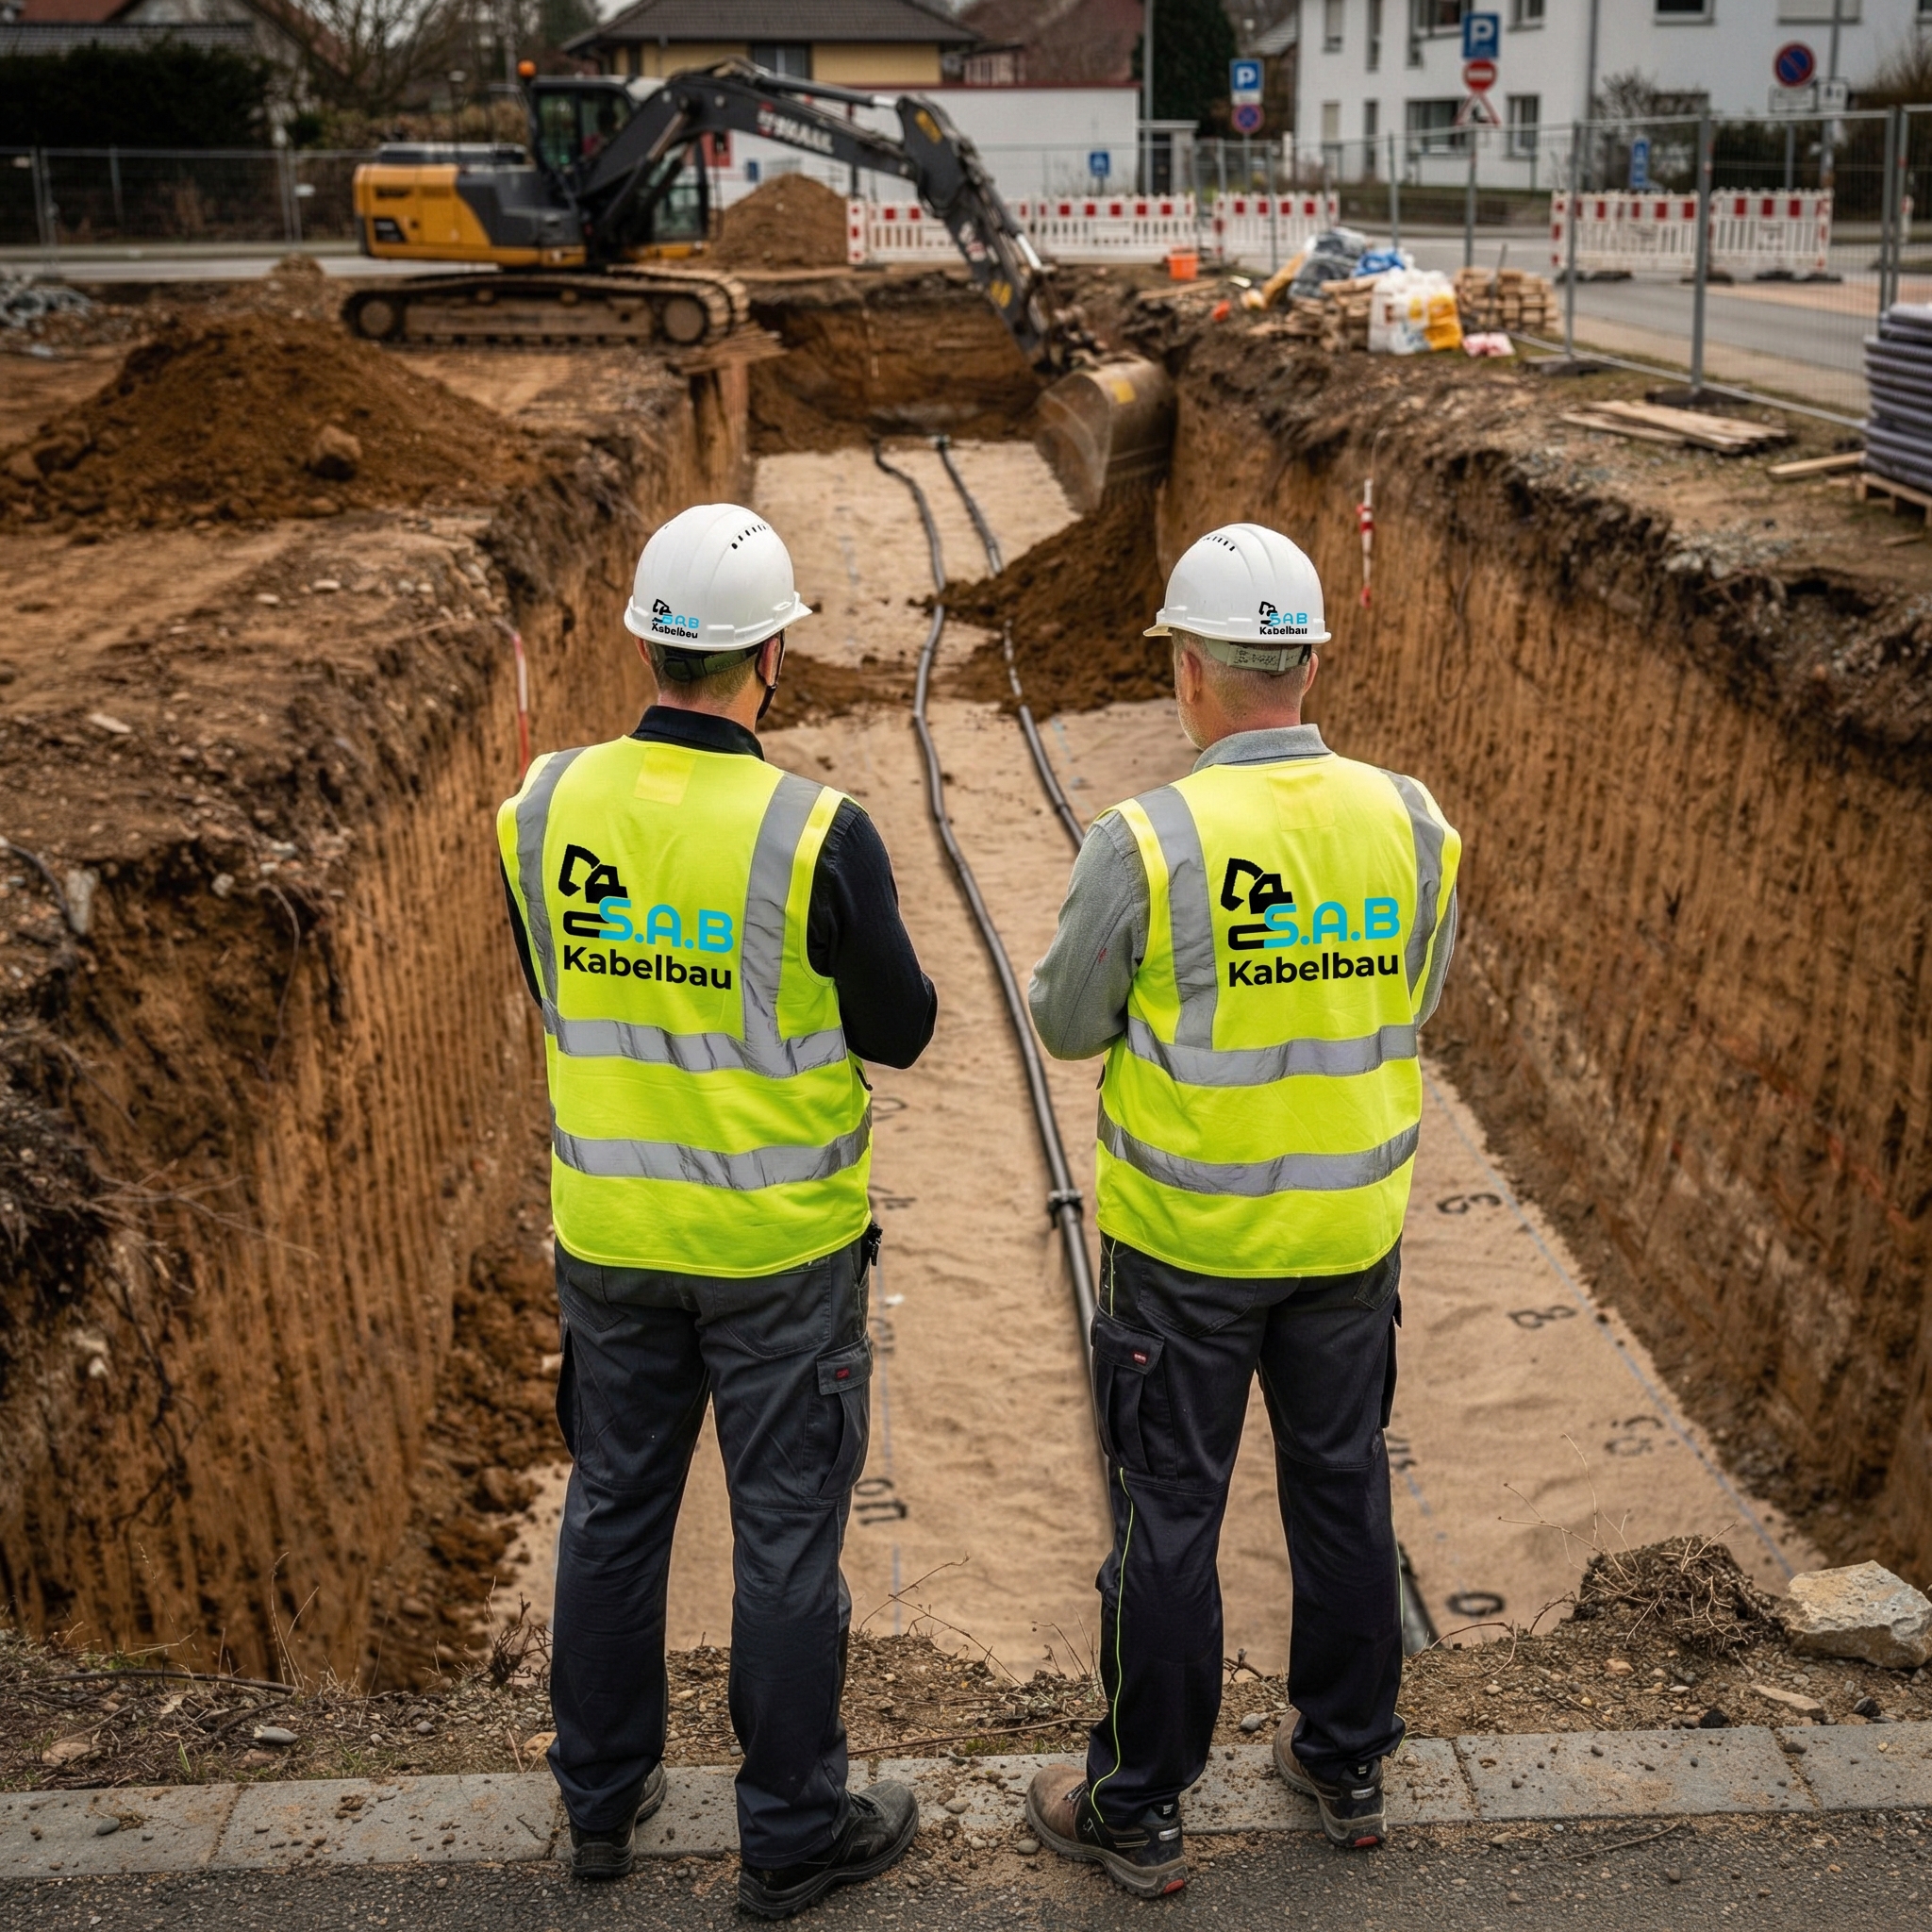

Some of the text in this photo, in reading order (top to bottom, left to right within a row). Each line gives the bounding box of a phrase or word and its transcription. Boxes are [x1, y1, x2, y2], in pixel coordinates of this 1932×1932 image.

[1470, 19, 1494, 48] P
[1236, 65, 1257, 88] P
[1259, 625, 1307, 635] Kabelbau
[599, 896, 734, 954] S.A.B
[1263, 897, 1401, 949] S.A.B
[563, 944, 732, 990] Kabelbau
[1228, 952, 1399, 988] Kabelbau
